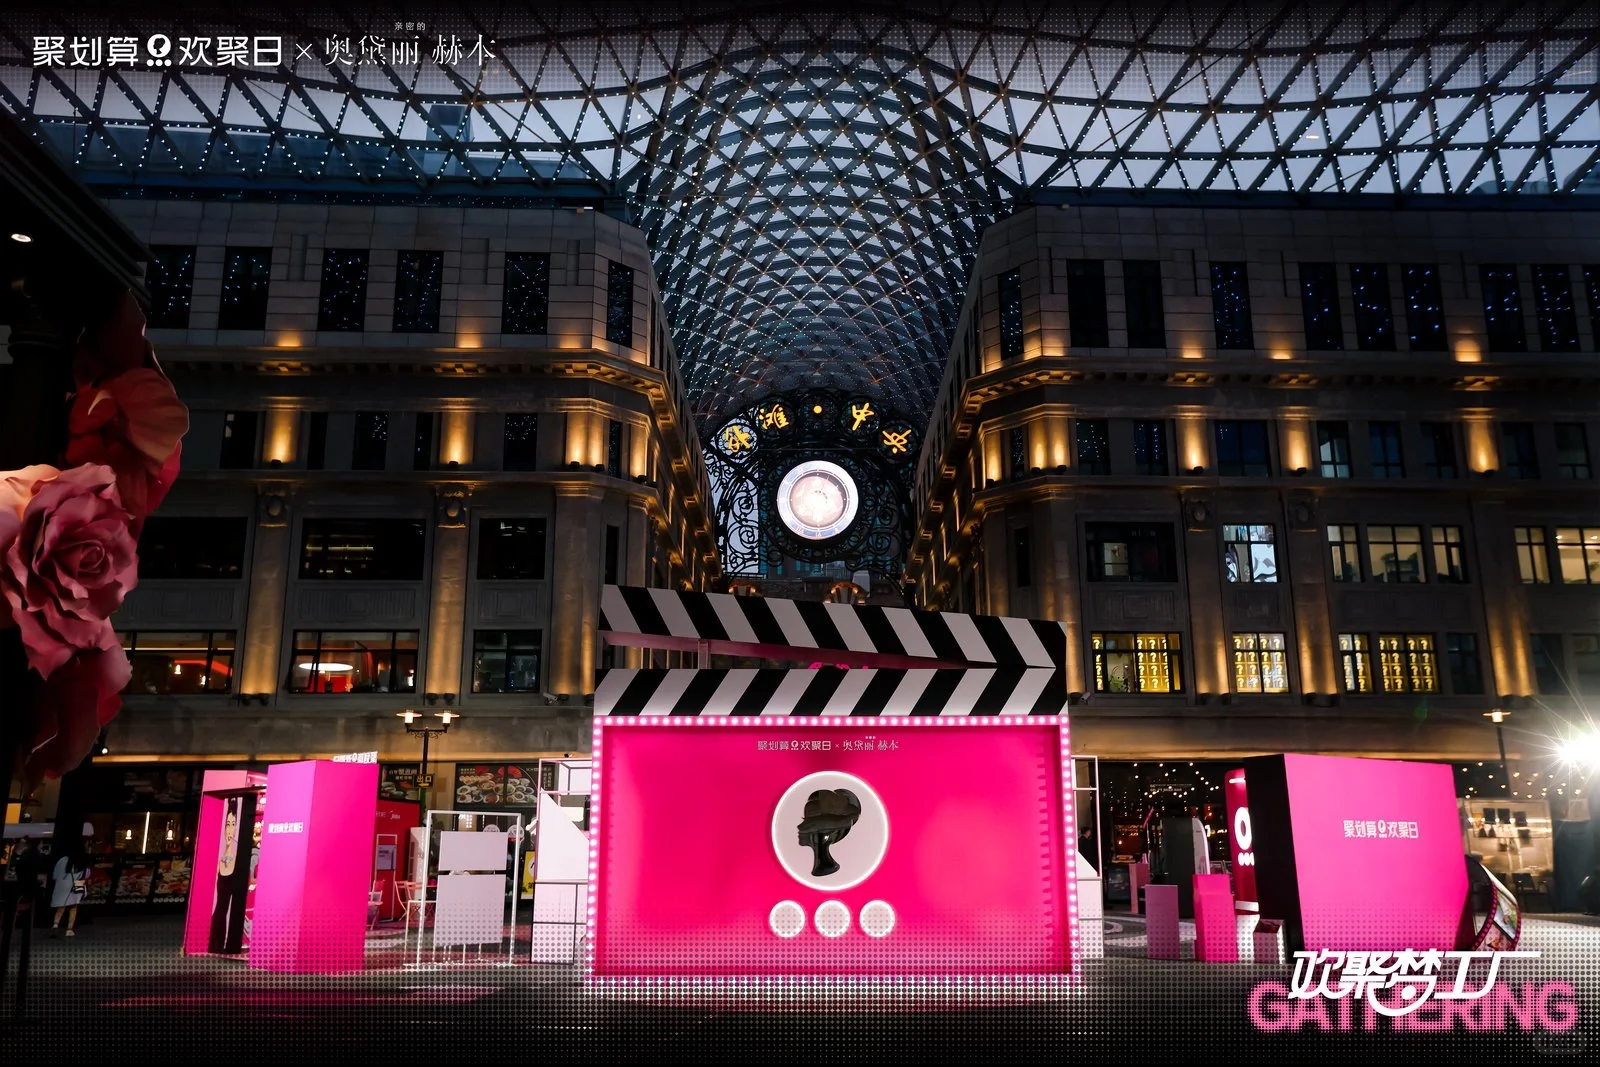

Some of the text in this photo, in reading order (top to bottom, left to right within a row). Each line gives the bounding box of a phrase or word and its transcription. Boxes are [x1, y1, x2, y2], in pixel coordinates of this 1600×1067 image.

[416, 774, 432, 783] 出口
[1343, 820, 1419, 839] 聚划算 欢聚日
